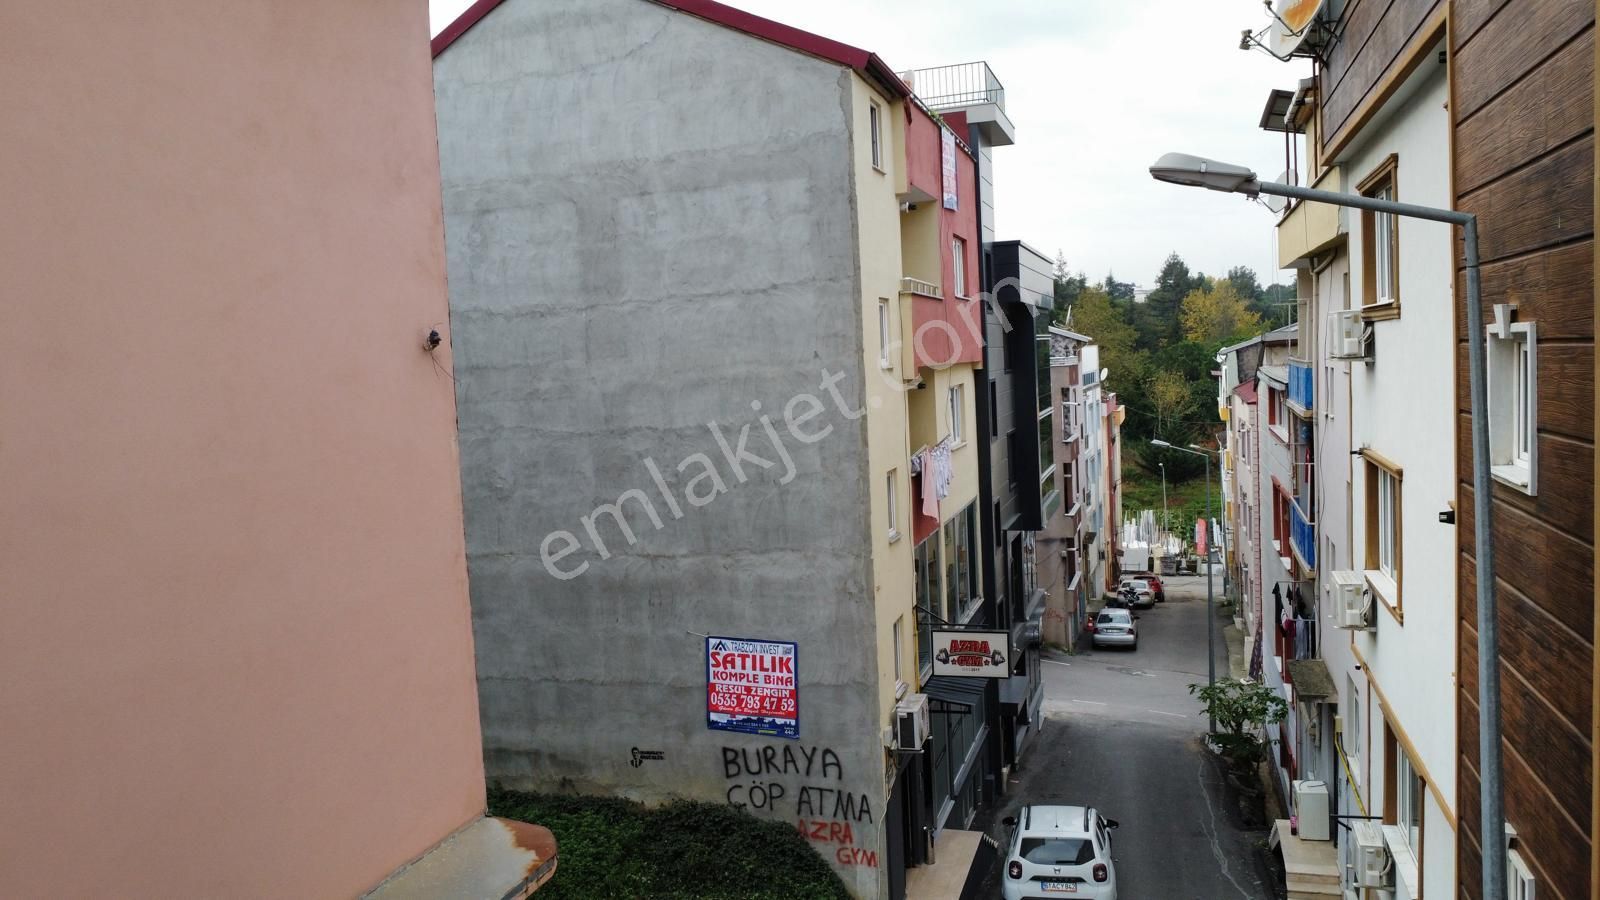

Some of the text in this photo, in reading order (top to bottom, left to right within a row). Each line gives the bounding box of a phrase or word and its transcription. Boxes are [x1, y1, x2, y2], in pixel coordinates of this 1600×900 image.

[731, 641, 779, 655] TRABZON INVEST
[949, 639, 991, 655] AZRA
[710, 651, 793, 674] SATILIK
[956, 655, 984, 667] GYM
[712, 670, 760, 683] KOMPLE
[715, 683, 748, 695] RESUL
[710, 692, 737, 707] 0535
[741, 694, 760, 709] 793
[763, 697, 777, 710] 47
[781, 698, 795, 712] 52
[722, 745, 842, 780] BURAYA
[797, 786, 873, 824] ATMA
[797, 819, 853, 844] AZRA
[836, 847, 878, 868] GYM
